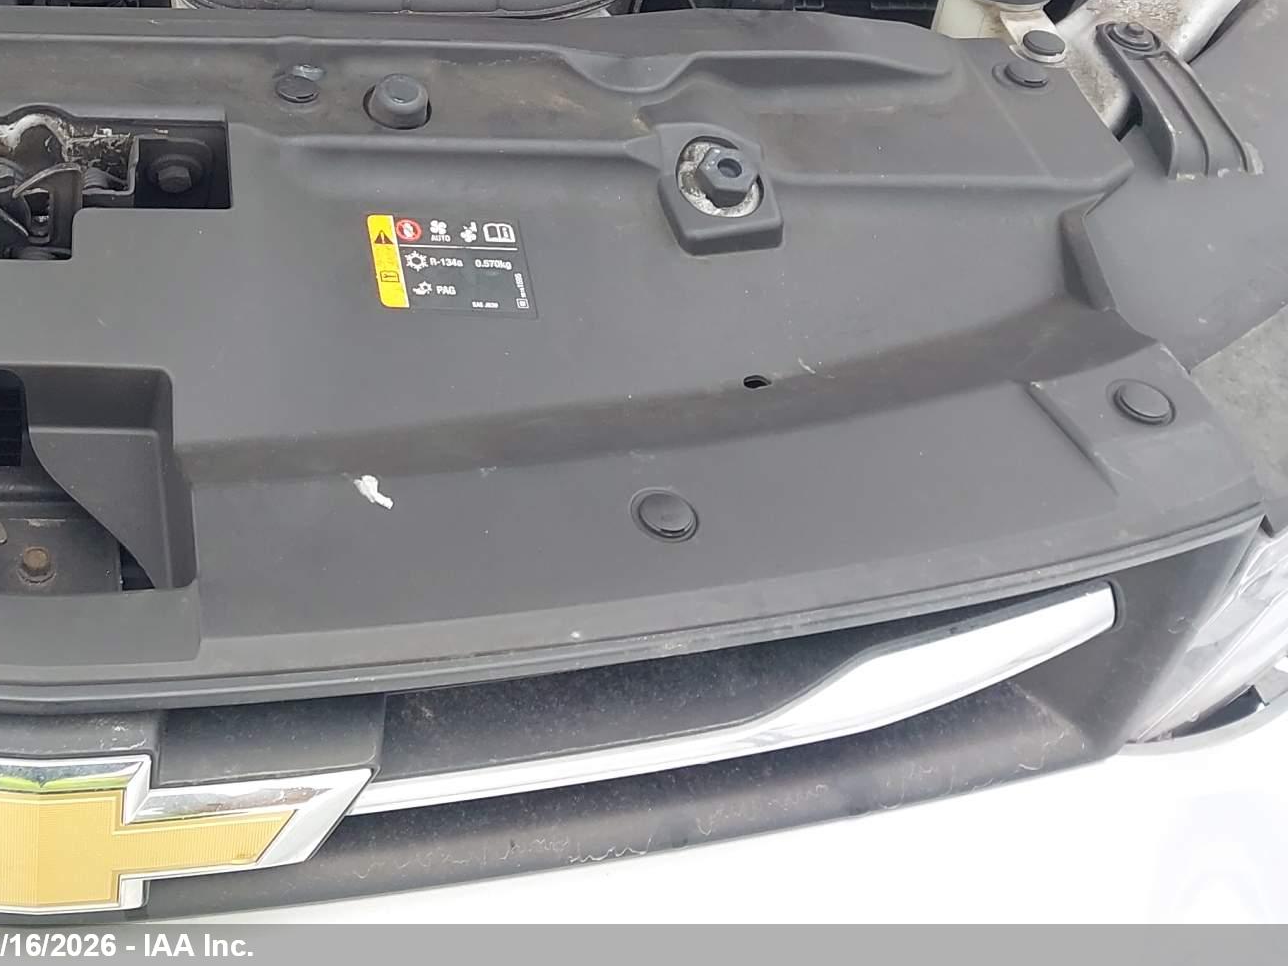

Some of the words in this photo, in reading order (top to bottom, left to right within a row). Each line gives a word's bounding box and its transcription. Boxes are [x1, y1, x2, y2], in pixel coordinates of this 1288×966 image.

[431, 233, 451, 242] AUTO
[429, 257, 464, 268] R-134a
[436, 285, 456, 296] PAG
